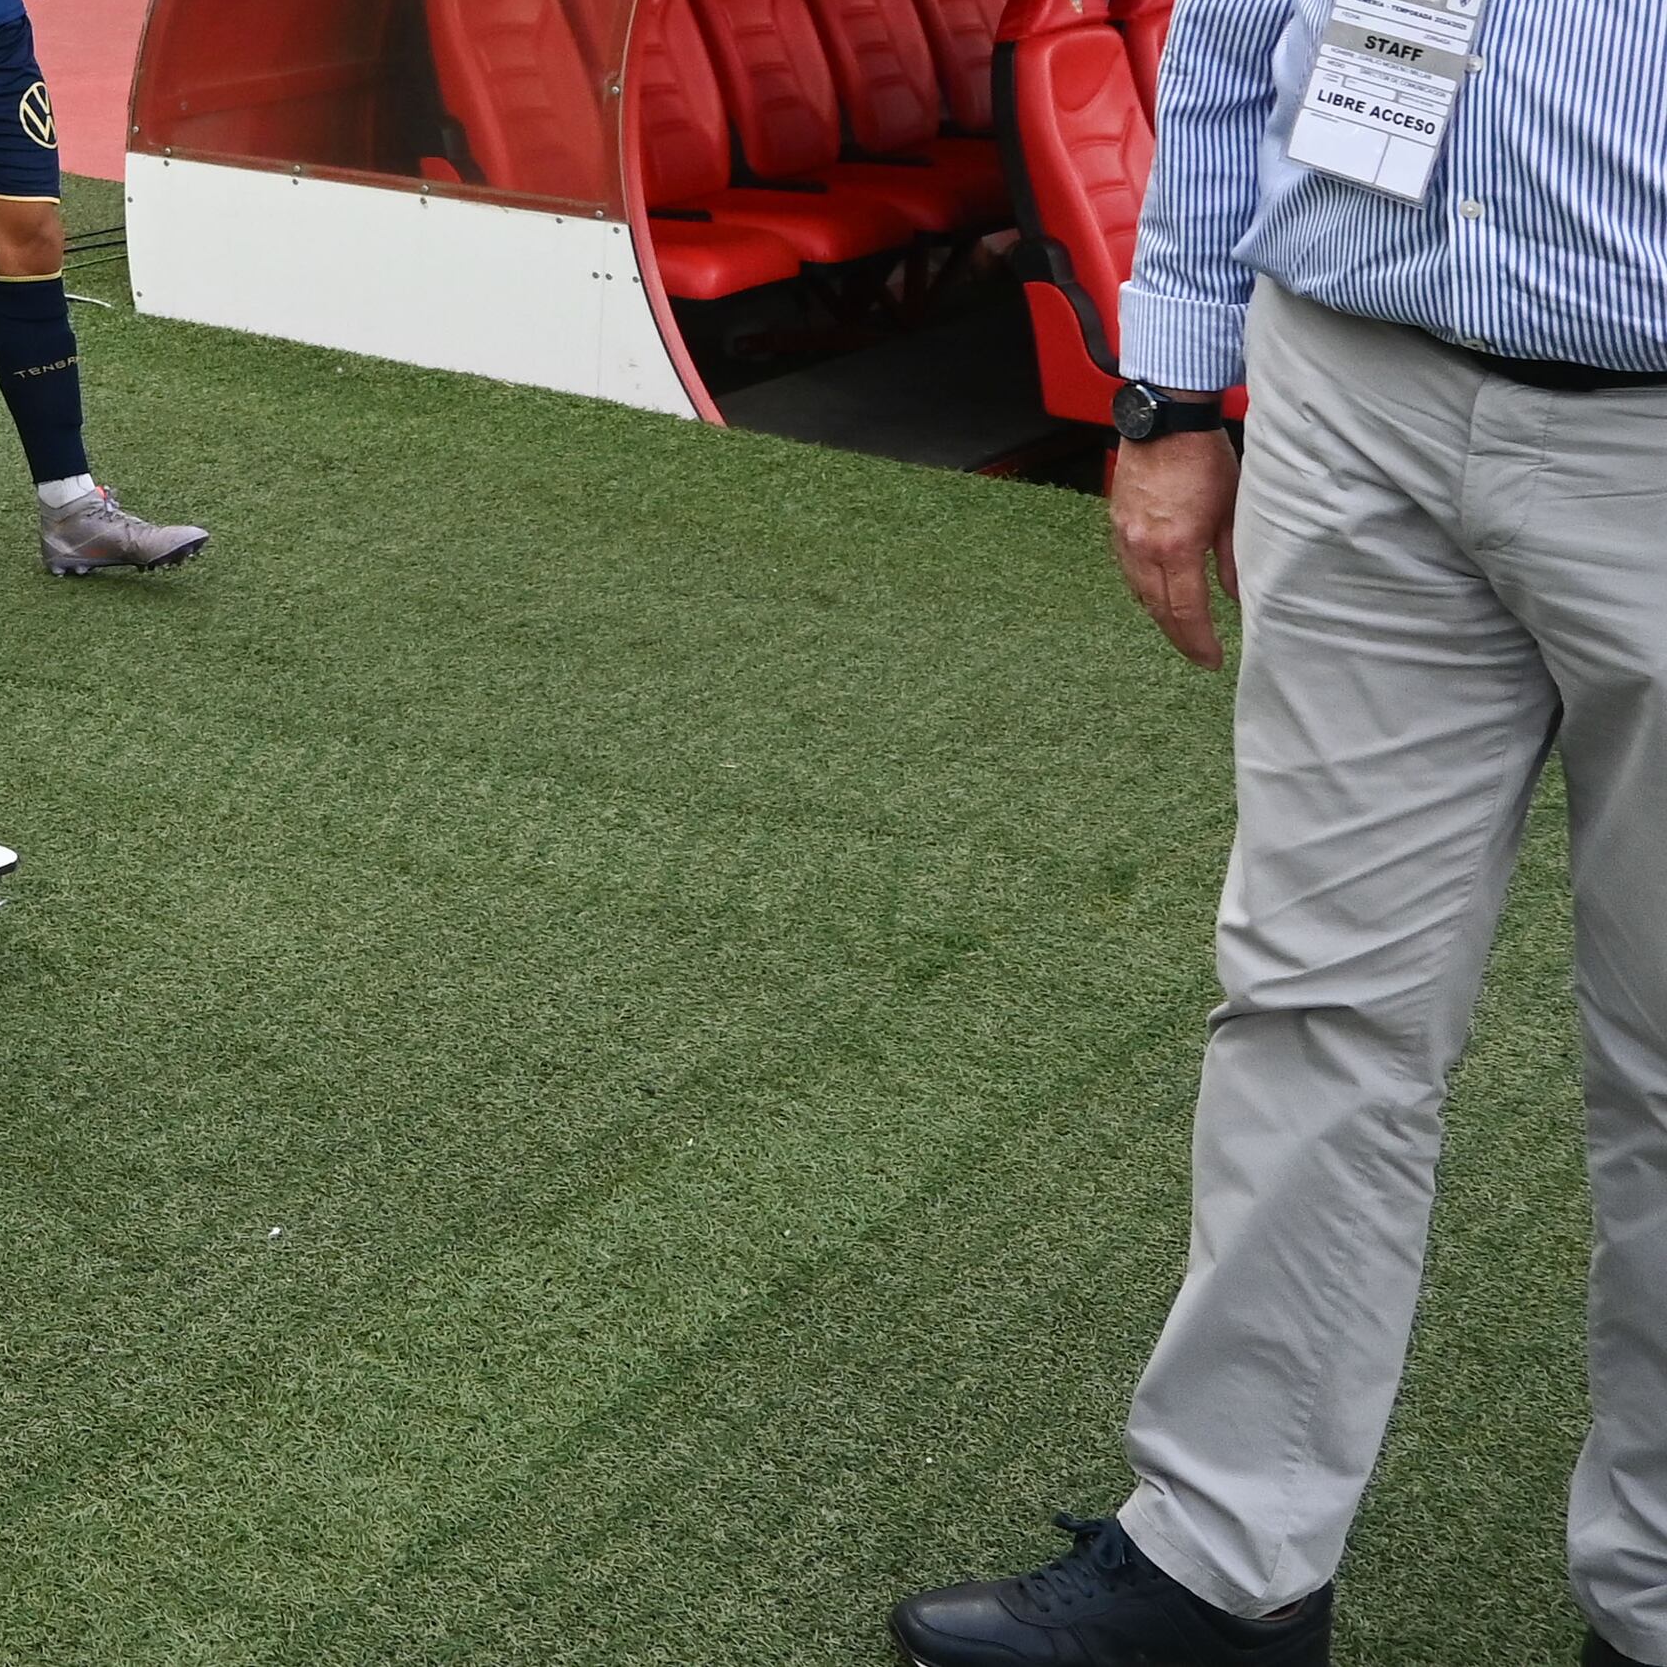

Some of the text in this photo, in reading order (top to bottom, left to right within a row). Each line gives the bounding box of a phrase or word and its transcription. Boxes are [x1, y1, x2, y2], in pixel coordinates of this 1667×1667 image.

[1364, 35, 1424, 62] STAFF
[1316, 88, 1367, 114] LIBRE
[1369, 105, 1436, 135] ACCESO
[14, 355, 81, 380] TENER
